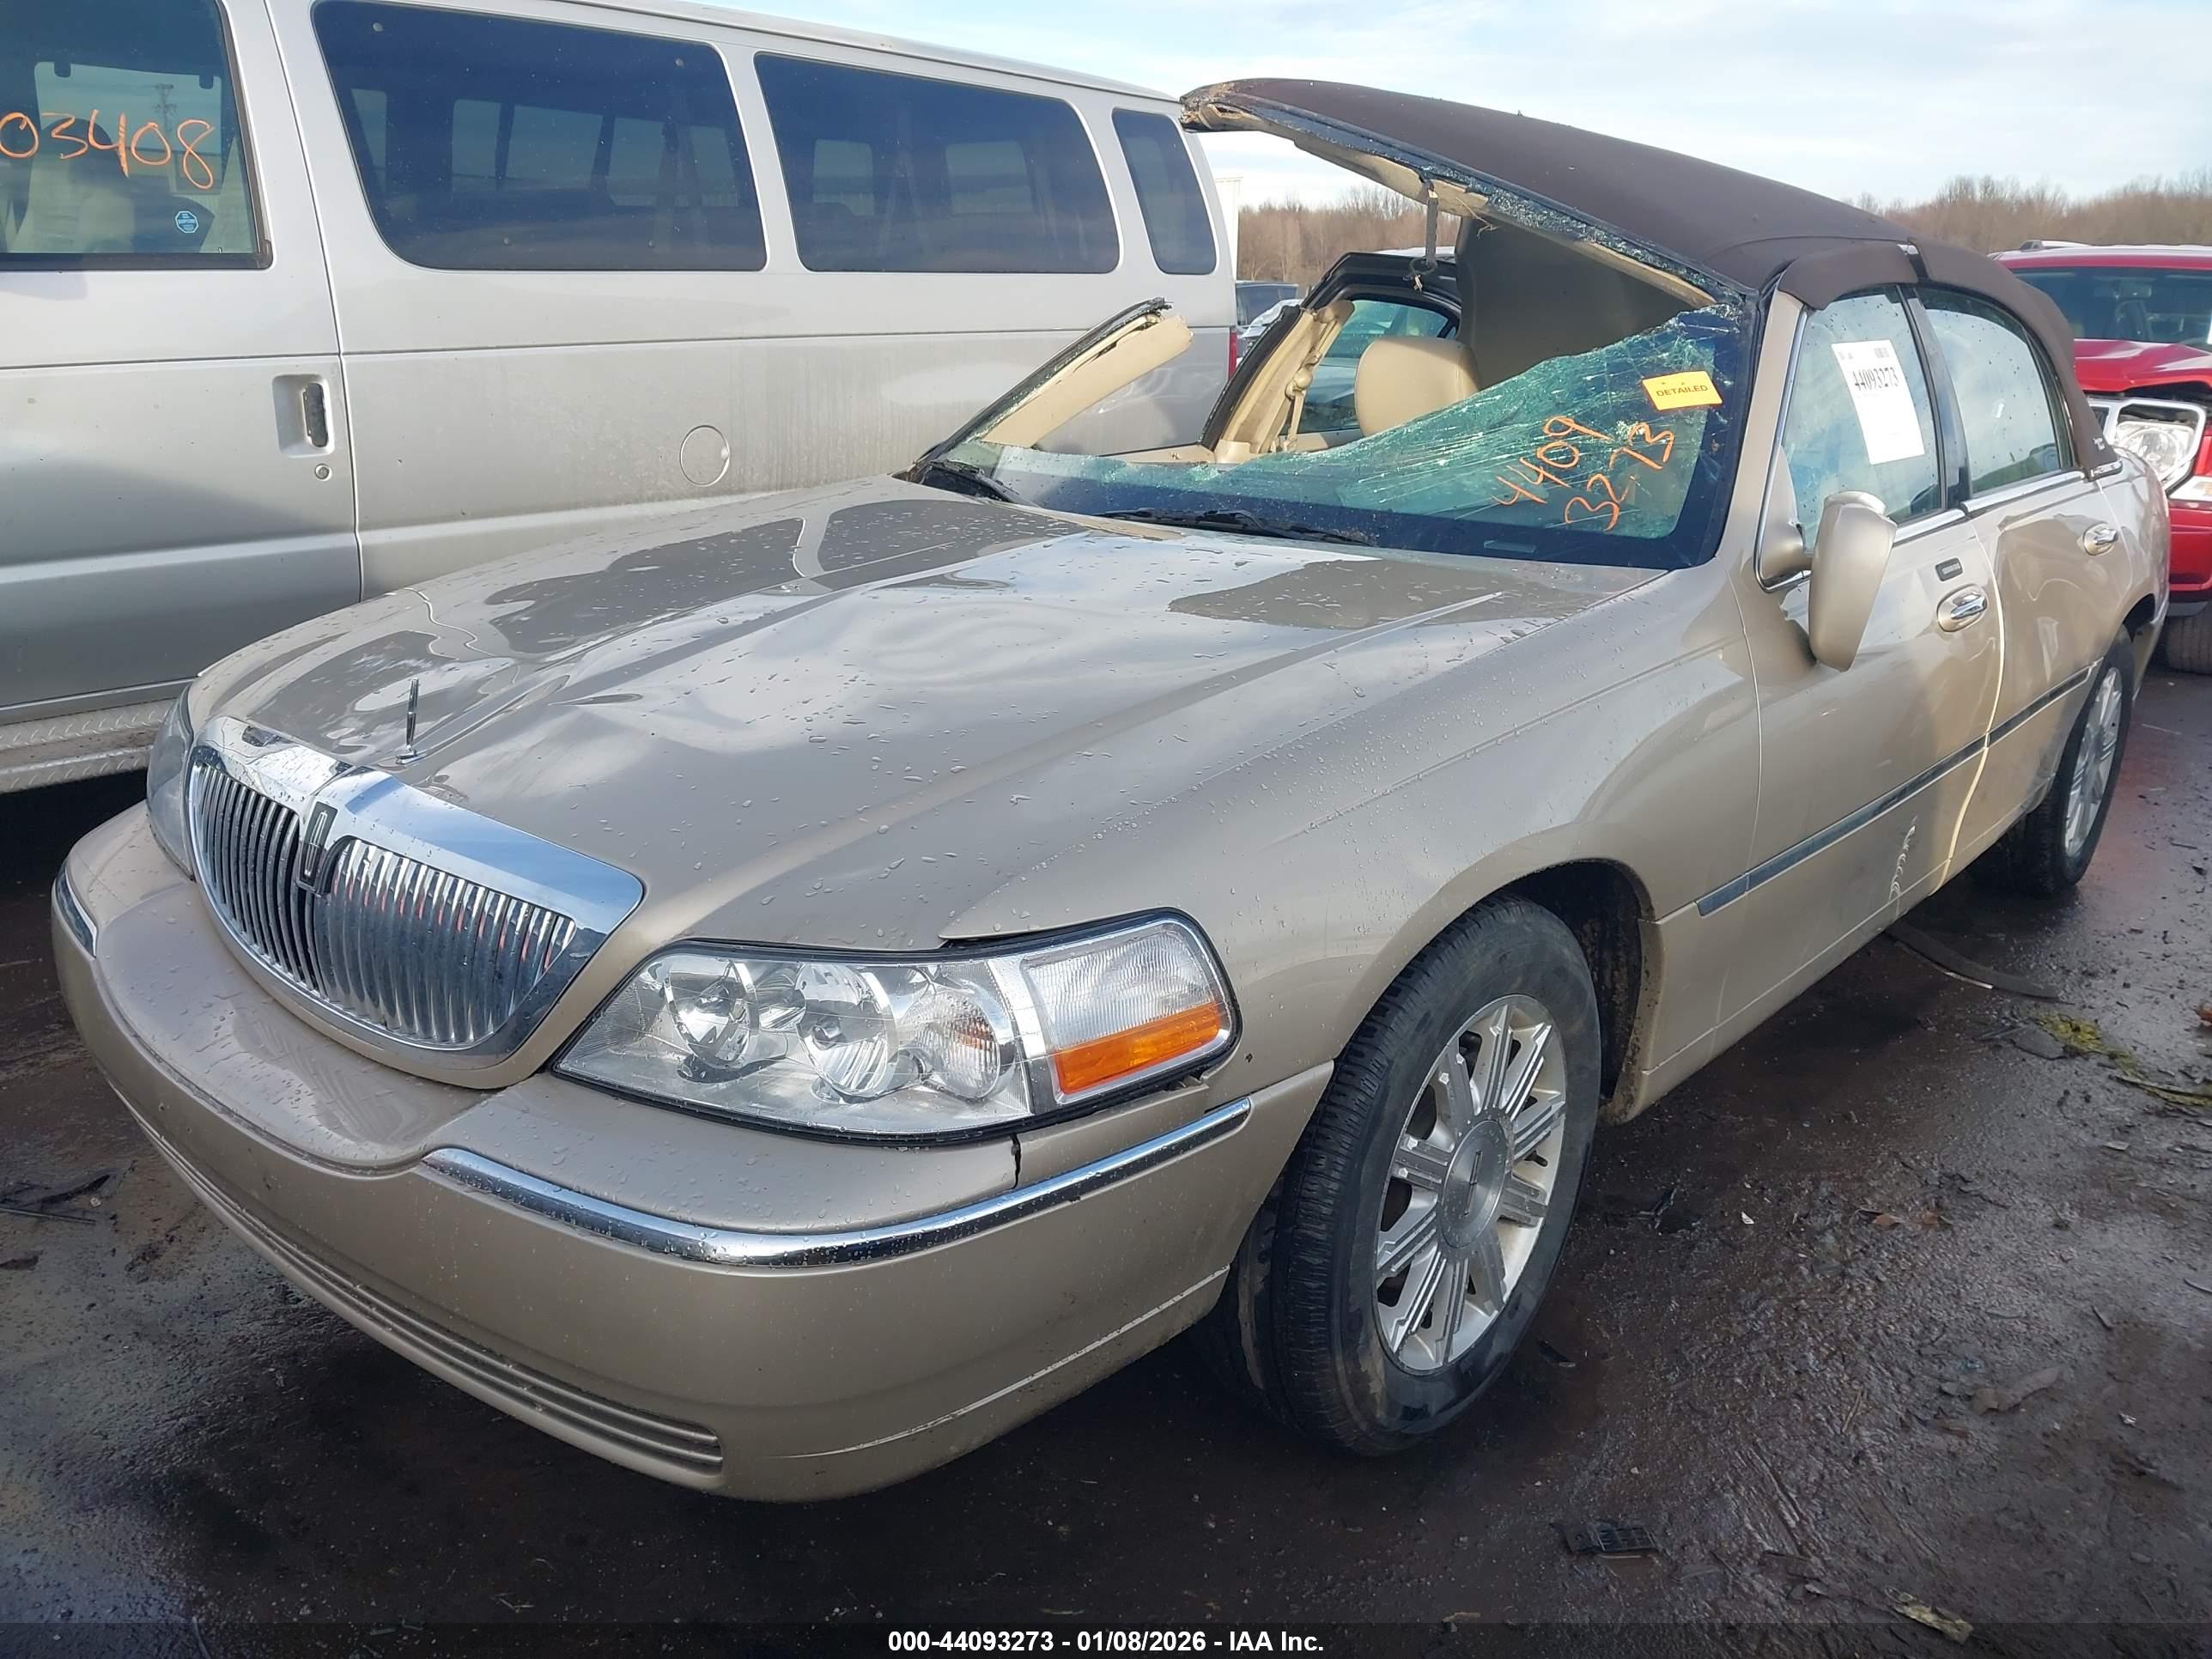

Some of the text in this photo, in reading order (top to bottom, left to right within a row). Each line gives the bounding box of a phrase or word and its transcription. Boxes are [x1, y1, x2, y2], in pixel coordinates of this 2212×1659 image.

[0, 109, 215, 190] 03408
[1656, 384, 1709, 397] DETAILED
[1852, 367, 1899, 392] 44093273
[1491, 415, 1615, 505] 4409
[1565, 422, 1675, 531] 3273
